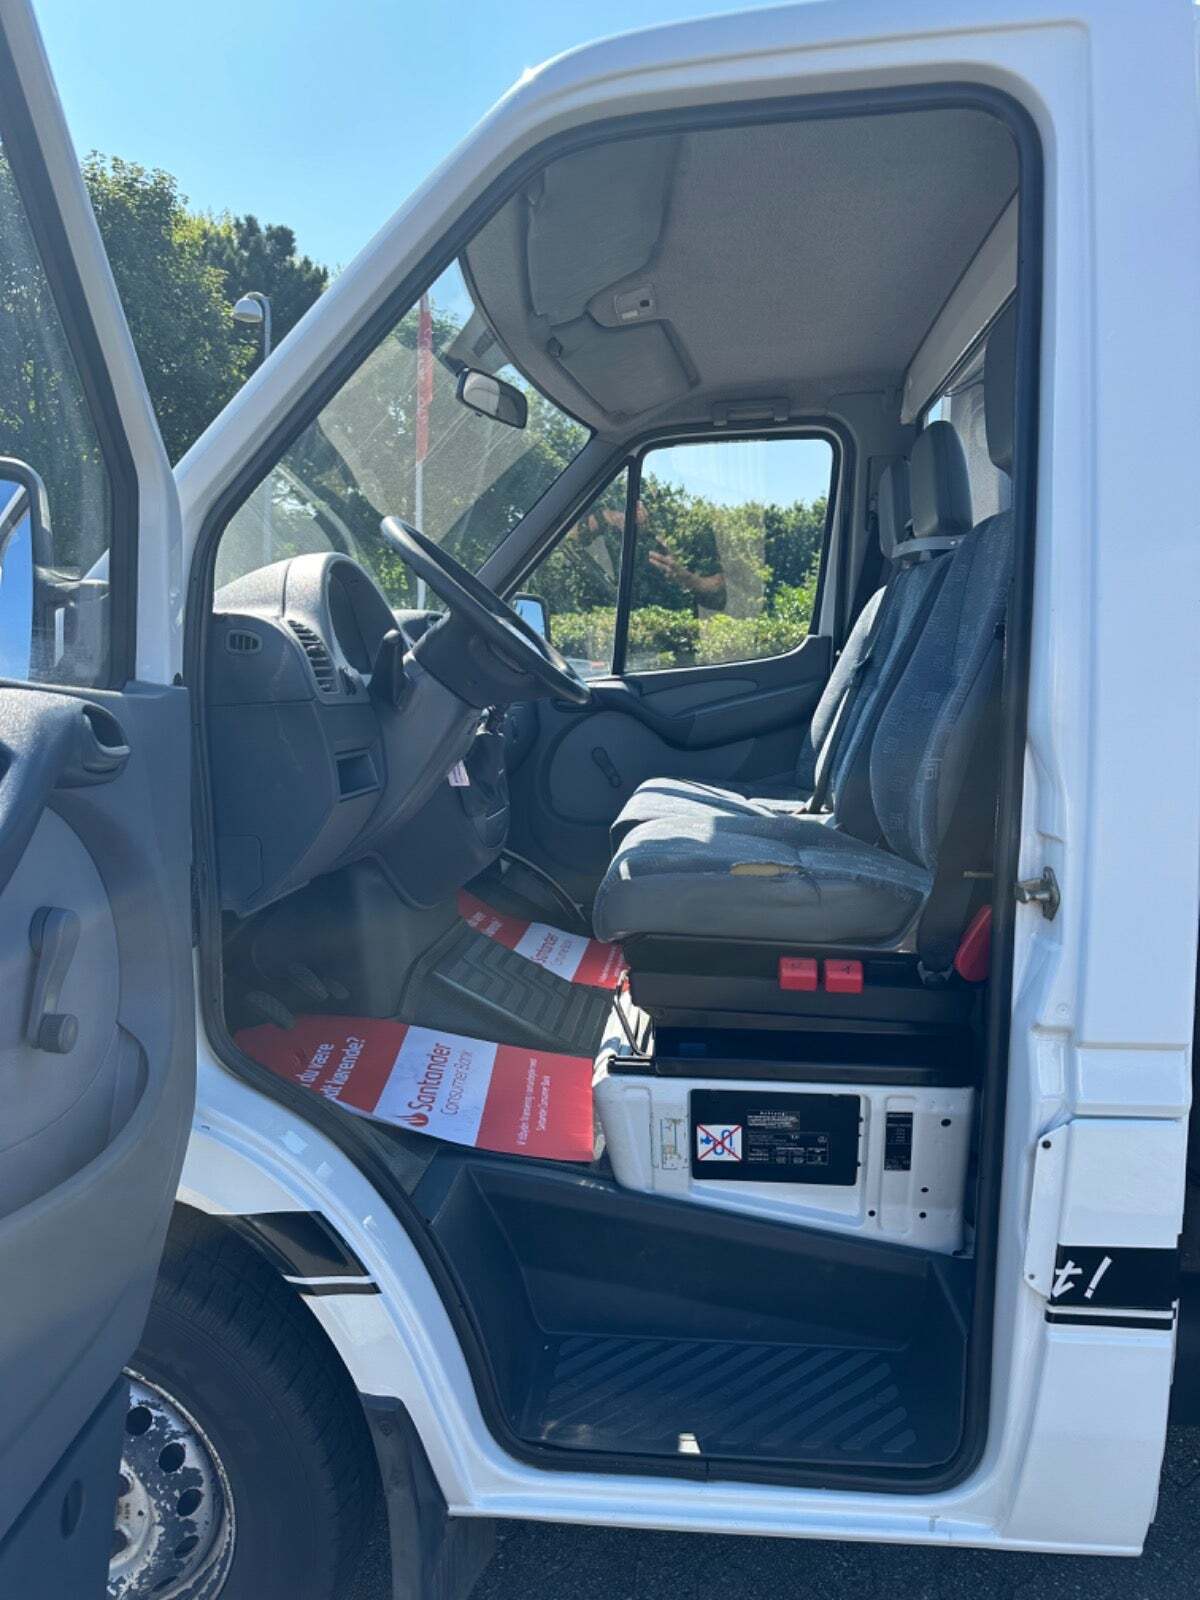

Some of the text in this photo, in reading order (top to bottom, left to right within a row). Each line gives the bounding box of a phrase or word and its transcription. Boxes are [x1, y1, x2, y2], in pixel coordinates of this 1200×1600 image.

[296, 1069, 320, 1083] du
[308, 1043, 335, 1069] være
[325, 1036, 366, 1085] kørende?
[407, 1042, 452, 1112] Santander
